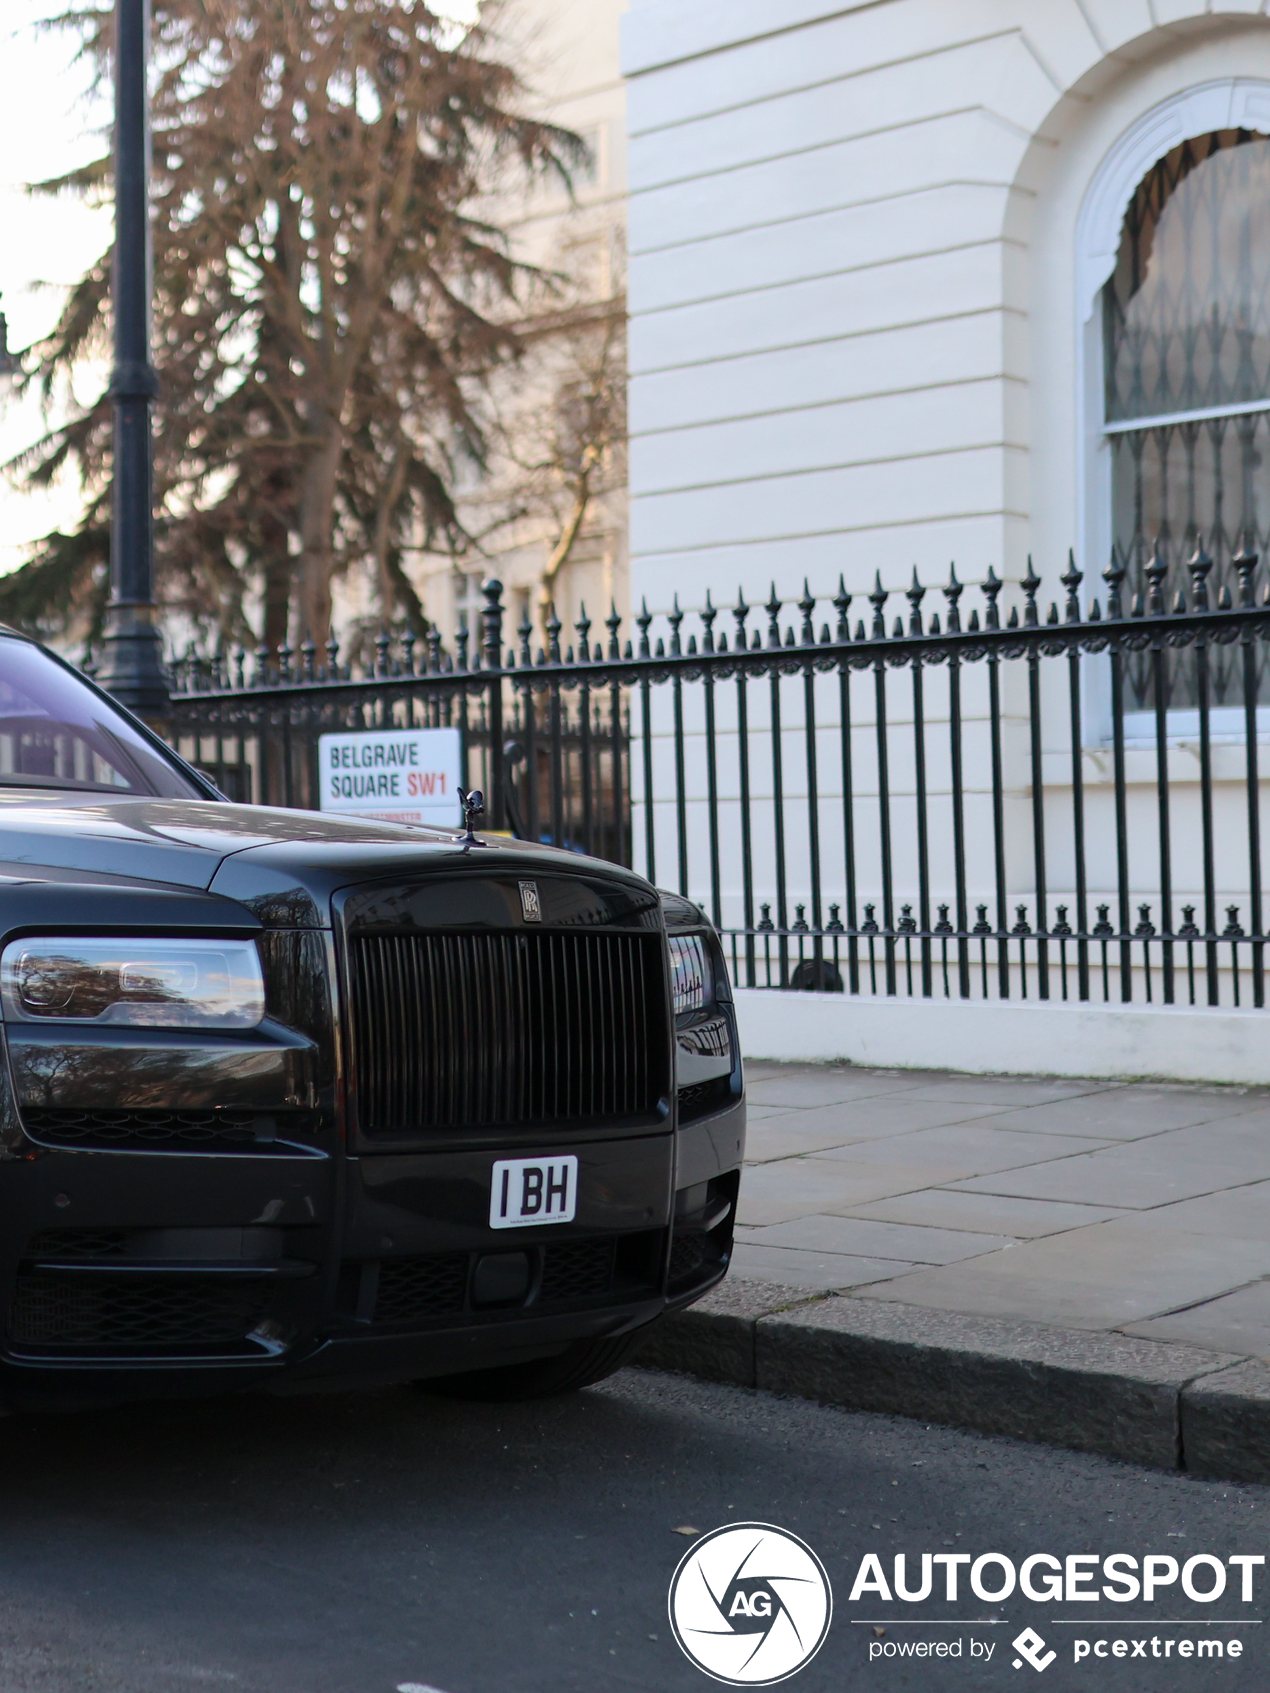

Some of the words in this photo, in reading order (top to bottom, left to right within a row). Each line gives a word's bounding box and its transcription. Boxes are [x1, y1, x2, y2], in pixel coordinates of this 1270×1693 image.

[330, 742, 418, 768] BELGRAVE
[331, 773, 399, 798] SQUARE
[407, 772, 446, 796] SW1
[520, 1165, 568, 1216] BH
